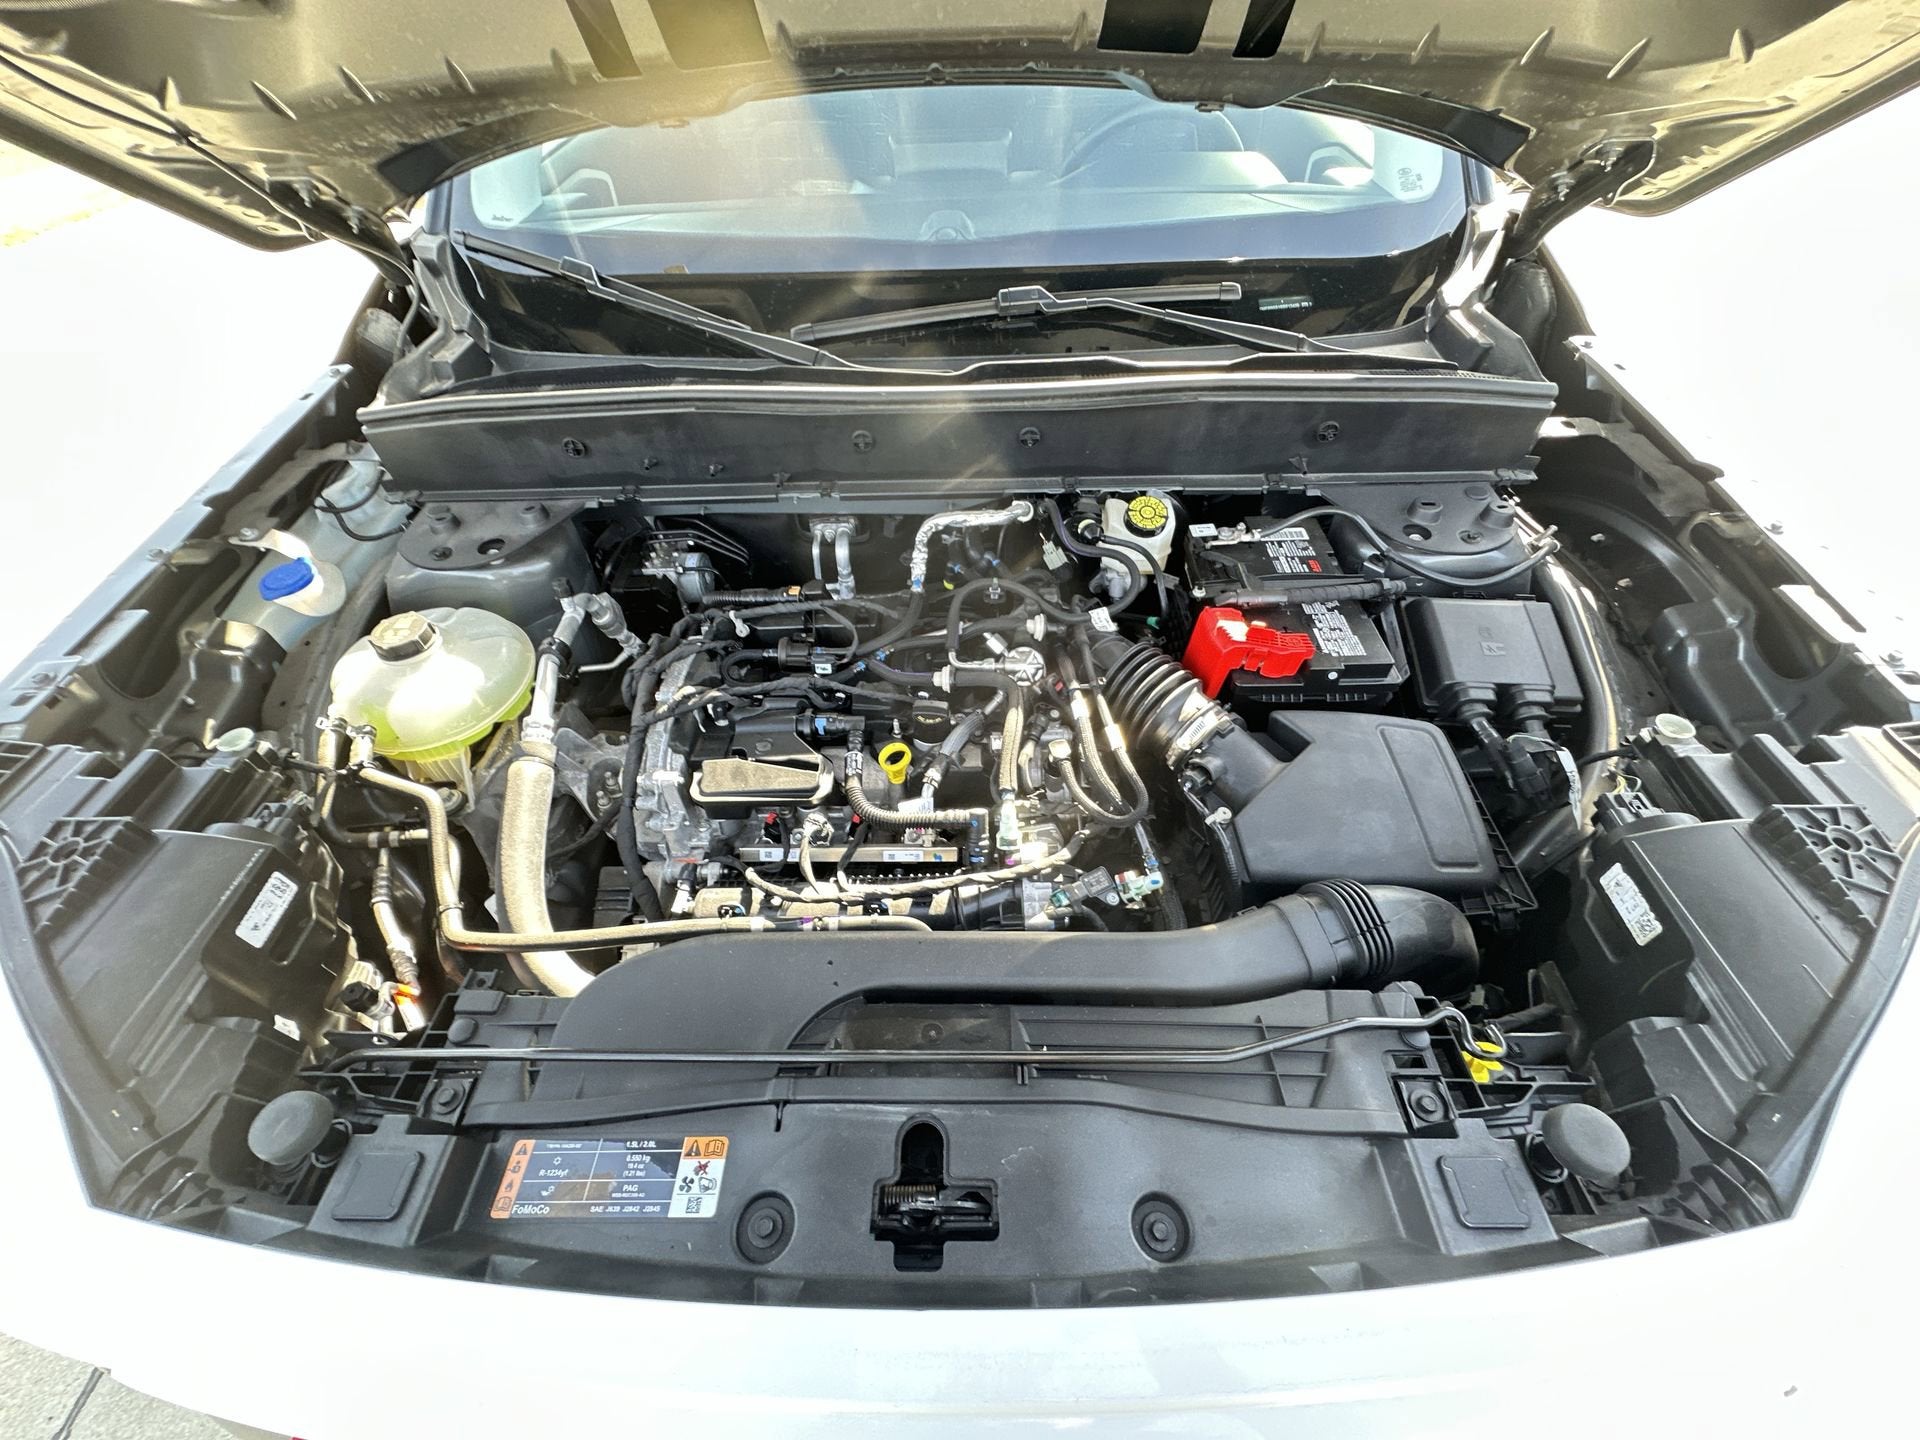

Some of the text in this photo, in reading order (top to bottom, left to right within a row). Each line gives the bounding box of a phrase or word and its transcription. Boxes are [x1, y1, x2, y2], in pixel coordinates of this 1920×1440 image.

[642, 1154, 651, 1163] kg
[538, 1168, 569, 1178] R-1234yf
[622, 1184, 639, 1192] PAG
[511, 1204, 550, 1214] FoMoCo
[590, 1205, 604, 1213] SAE
